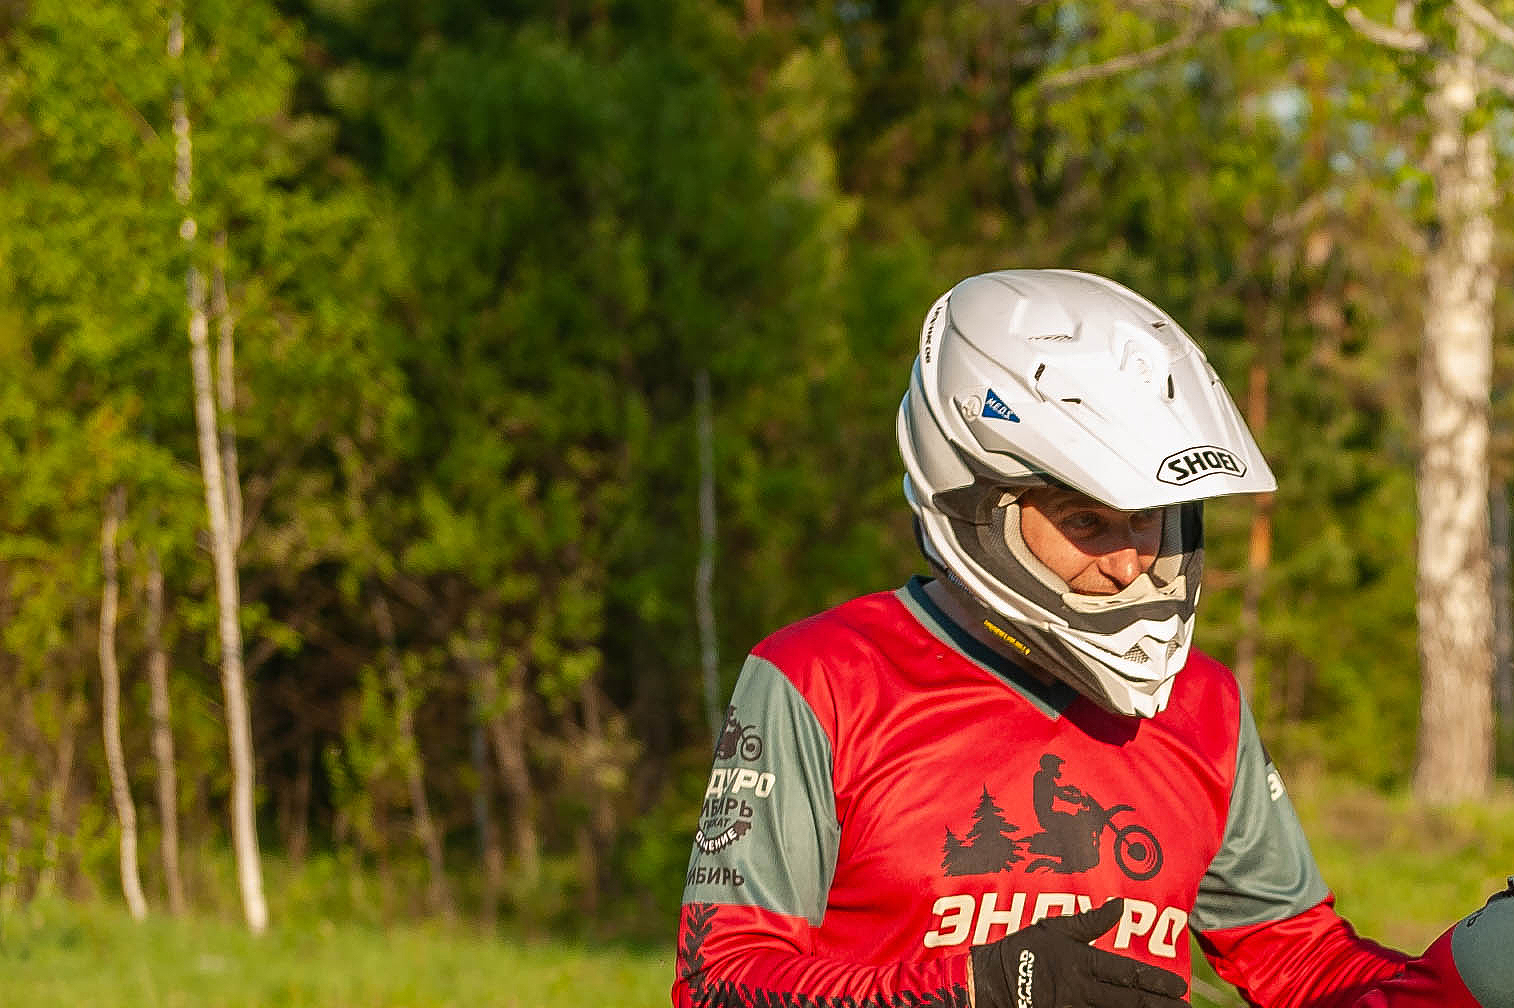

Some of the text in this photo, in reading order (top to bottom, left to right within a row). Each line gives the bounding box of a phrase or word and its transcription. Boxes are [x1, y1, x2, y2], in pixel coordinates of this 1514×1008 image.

[1168, 450, 1241, 481] SHOEI
[705, 768, 776, 799] ДУРО
[702, 797, 753, 817] ИБИРЬ
[687, 866, 745, 886] ИБИРЬ
